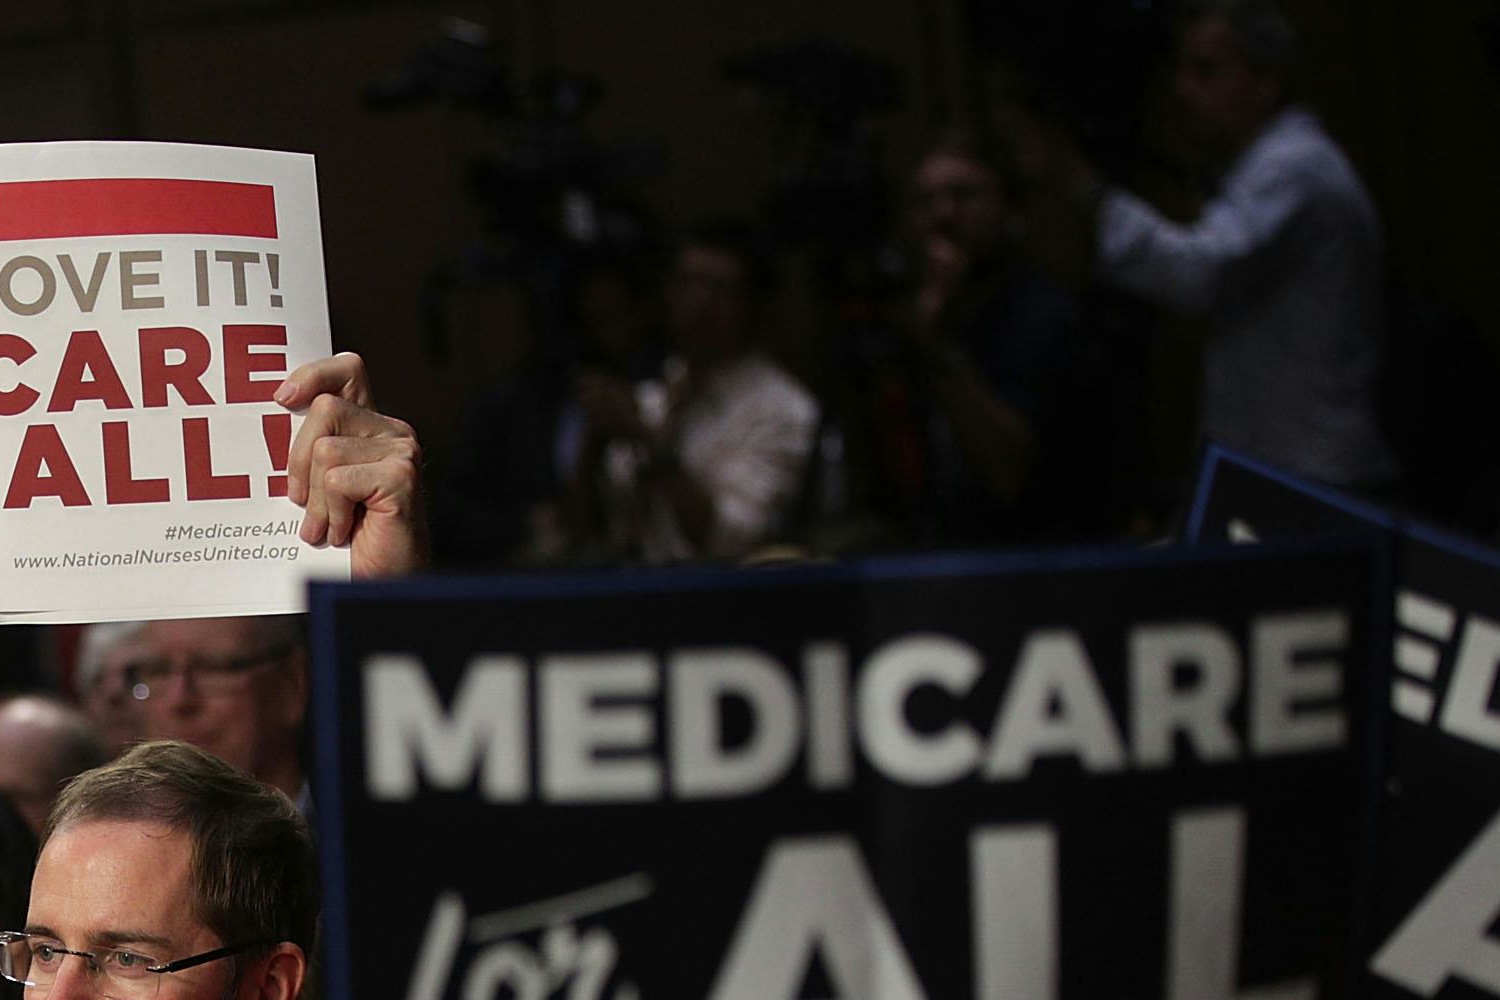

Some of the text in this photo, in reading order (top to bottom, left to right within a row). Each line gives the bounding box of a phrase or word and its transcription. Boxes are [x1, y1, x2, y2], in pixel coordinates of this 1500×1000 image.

[195, 250, 283, 307] IT!
[3, 413, 292, 509] ALL!
[14, 544, 299, 568] www.NationalNursesUnited.org
[165, 521, 299, 541] #Medicare4All
[362, 608, 1351, 803] MEDICARE
